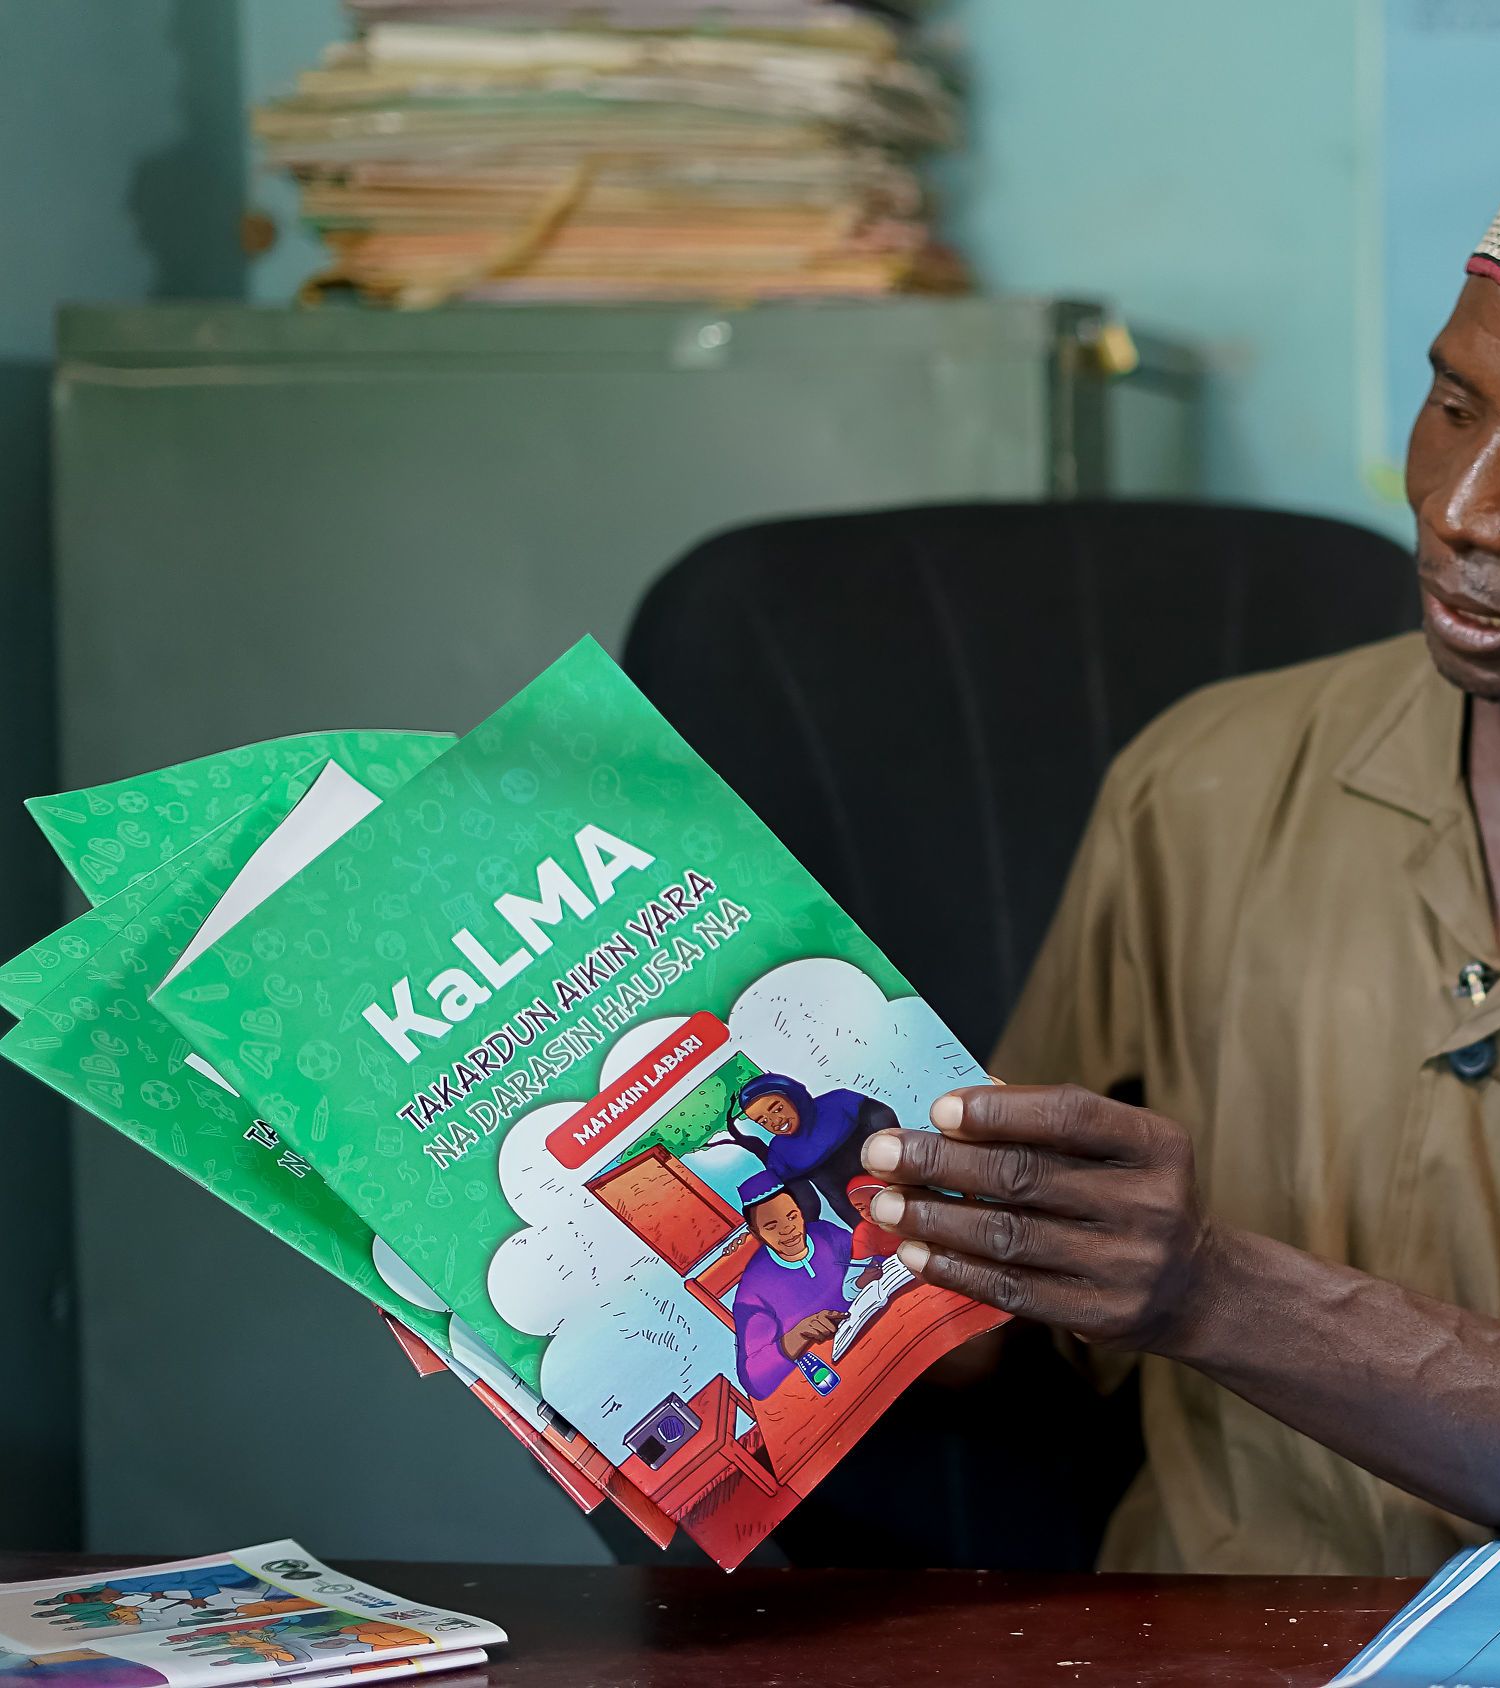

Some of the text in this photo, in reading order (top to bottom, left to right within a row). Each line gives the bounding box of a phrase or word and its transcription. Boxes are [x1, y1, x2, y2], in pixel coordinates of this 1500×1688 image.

[360, 823, 656, 1064] KaLMA
[396, 869, 717, 1133] TAKARDUN AIKIN YARA
[423, 898, 752, 1171] NA DARASIN HAUSA NA
[572, 1033, 704, 1146] MATAKIN LABARI
